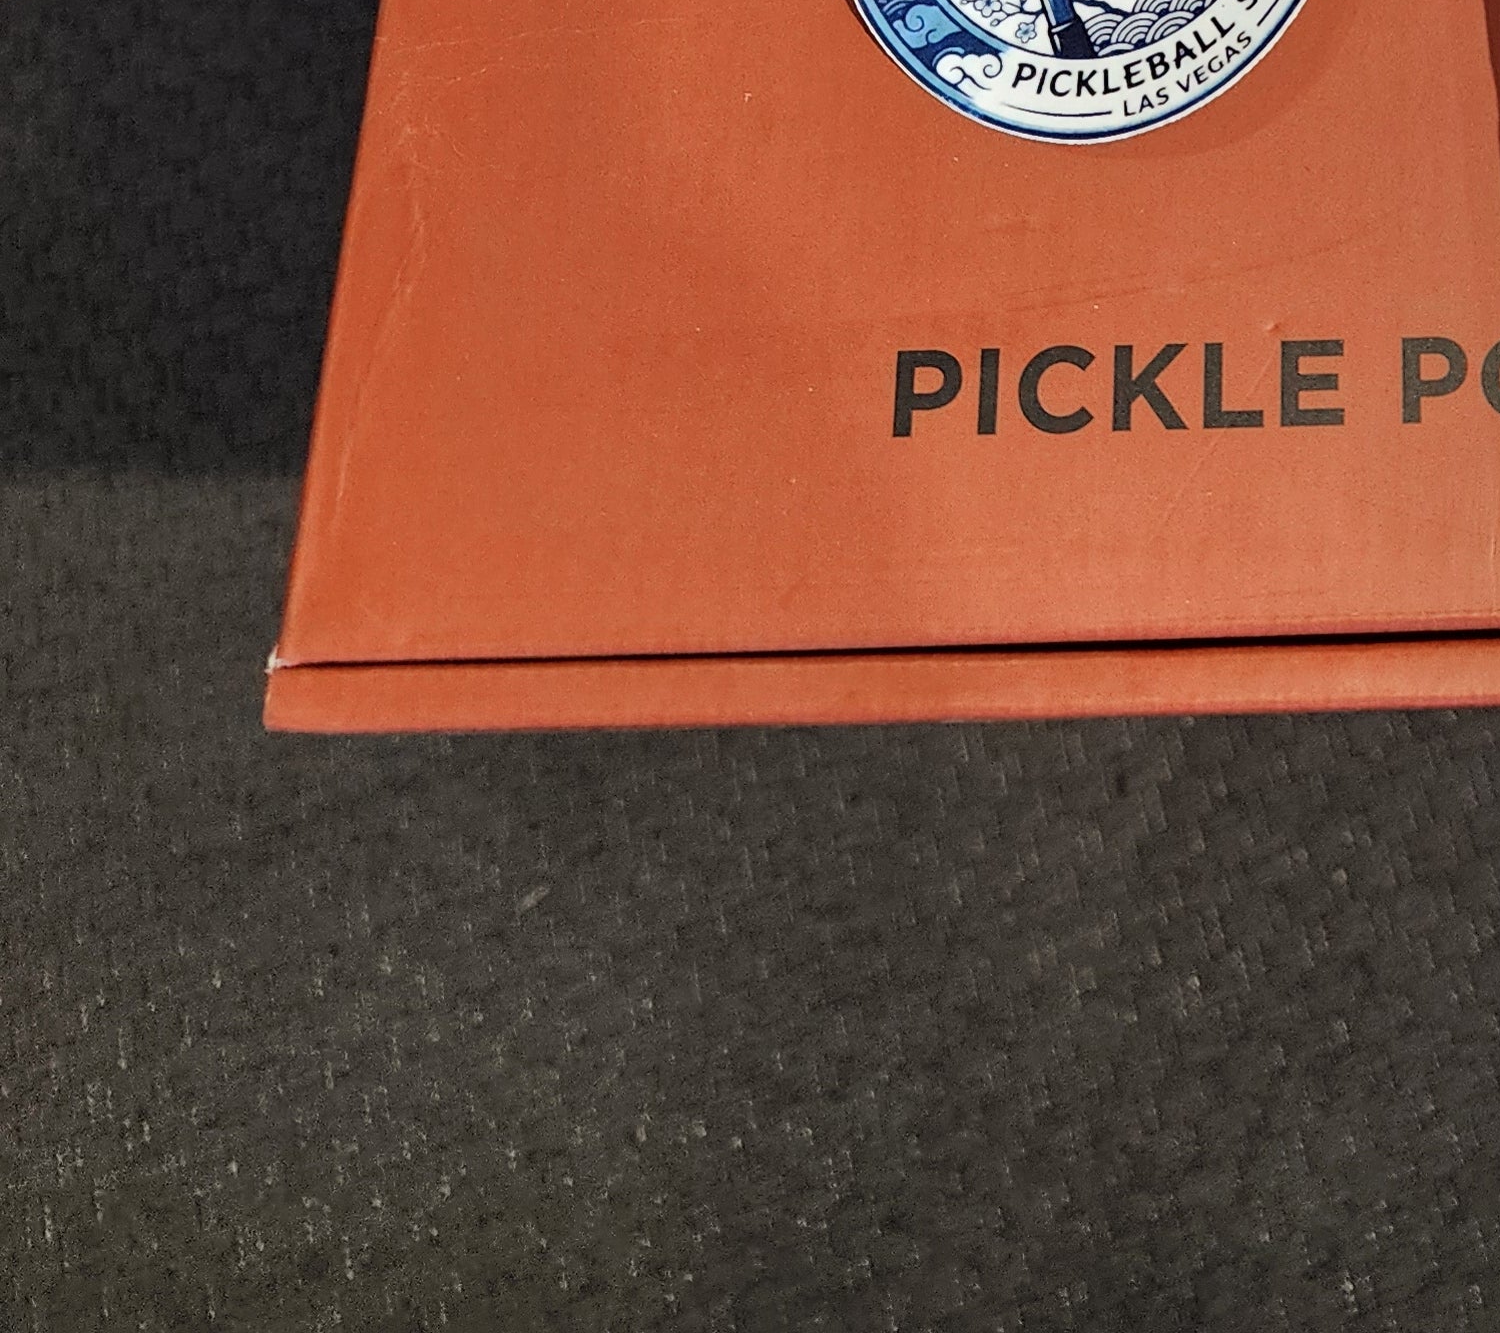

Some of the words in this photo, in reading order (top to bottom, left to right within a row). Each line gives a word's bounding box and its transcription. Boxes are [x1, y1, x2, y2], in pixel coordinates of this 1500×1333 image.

[1011, 15, 1236, 98] PICKLEBALL
[1122, 86, 1170, 118] LAS
[1175, 31, 1253, 94] VEGAS
[892, 339, 1346, 438] PICKLE
